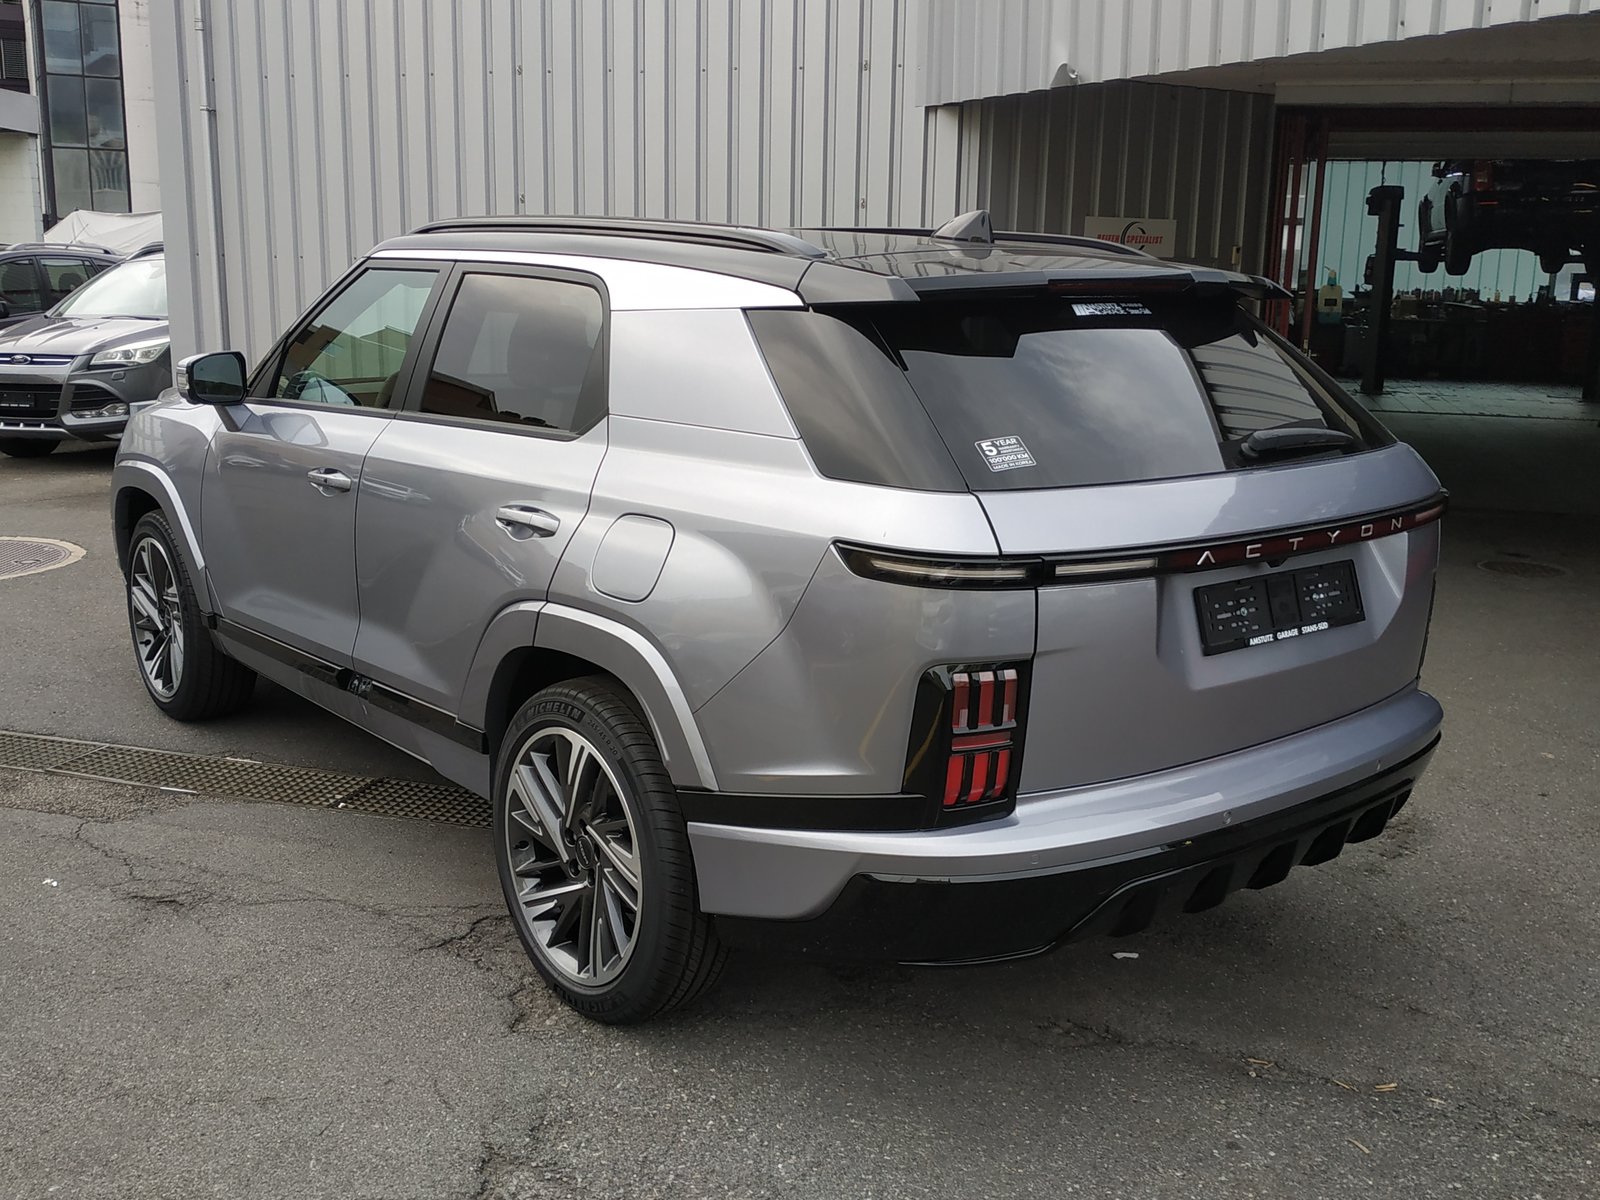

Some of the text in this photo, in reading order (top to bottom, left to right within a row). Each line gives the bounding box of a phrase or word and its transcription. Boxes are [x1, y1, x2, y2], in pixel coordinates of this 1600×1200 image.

[1126, 234, 1164, 245] SPEZIALIST
[981, 441, 998, 456] 5
[994, 438, 1018, 447] YEAR
[1197, 517, 1403, 566] ACTYON
[1249, 633, 1275, 646] AMSTUTZ
[1276, 628, 1299, 640] GARAGE
[526, 701, 582, 720] MICHELIN
